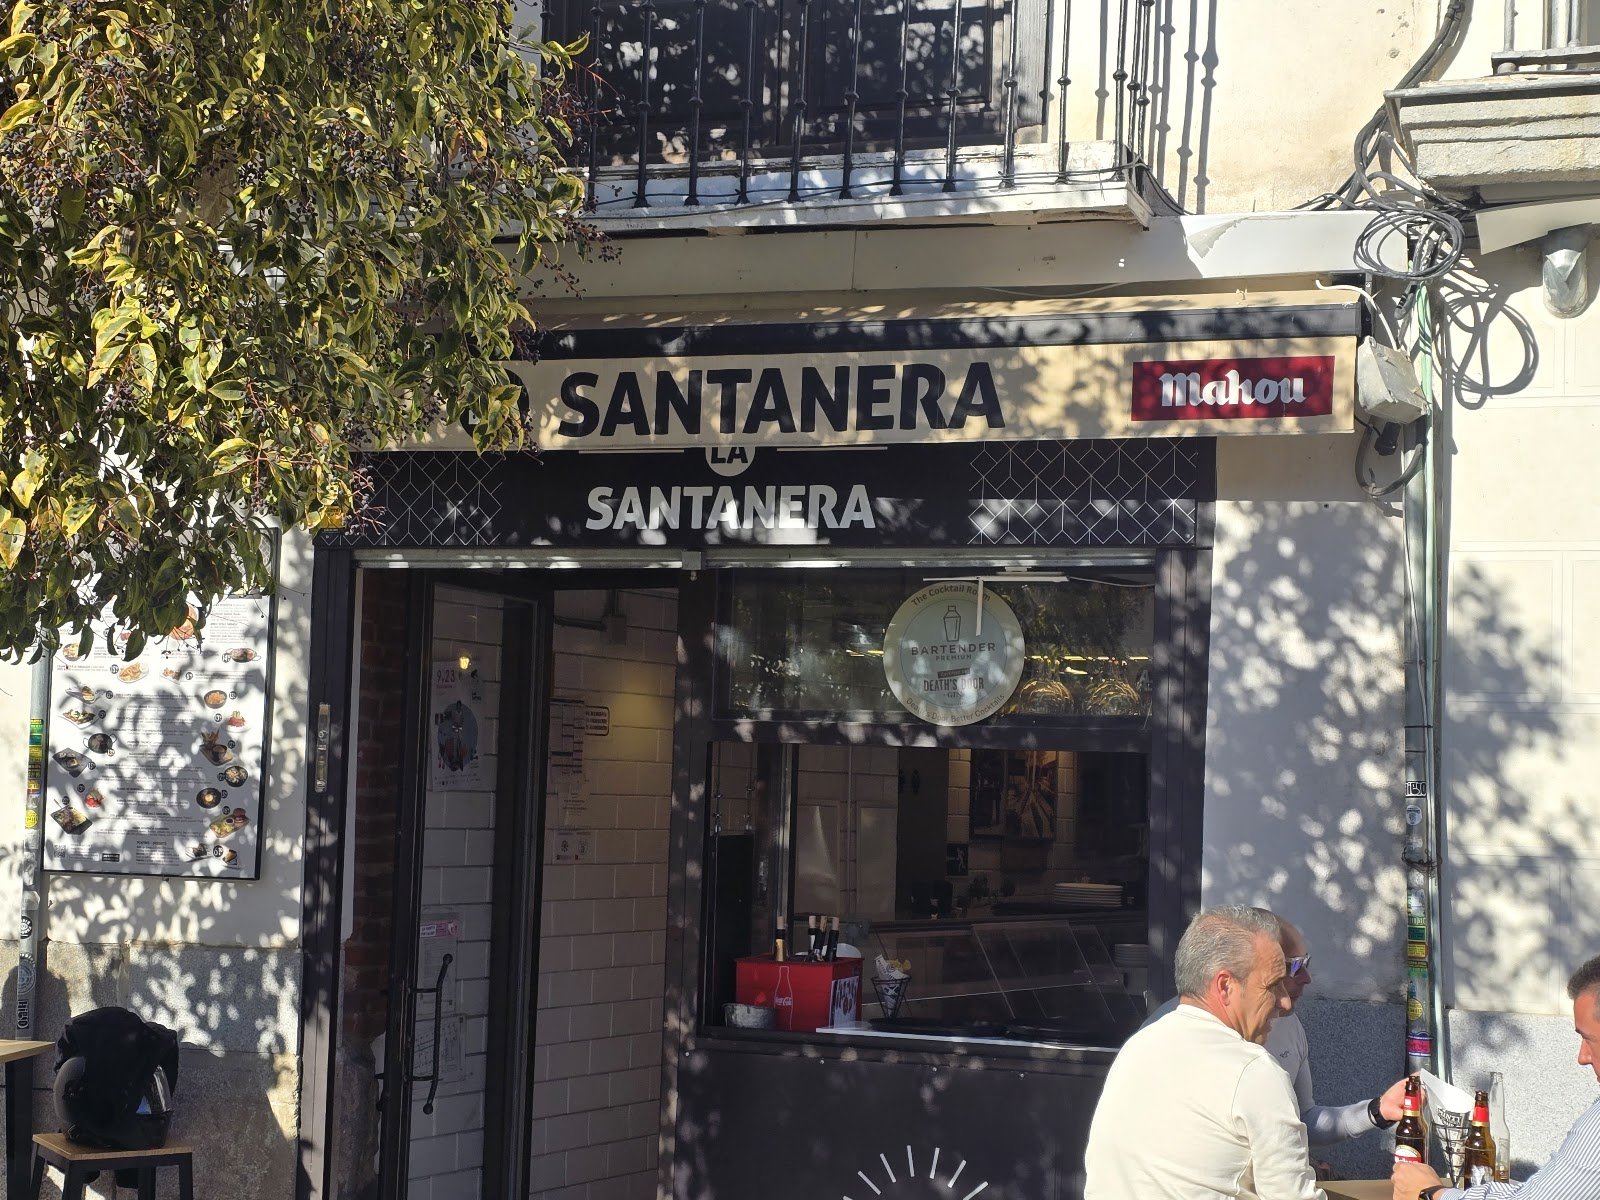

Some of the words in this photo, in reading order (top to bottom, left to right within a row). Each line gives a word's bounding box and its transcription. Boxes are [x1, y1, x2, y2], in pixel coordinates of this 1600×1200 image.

[558, 361, 1006, 438] SANTANERA
[1158, 369, 1306, 407] Mahou
[710, 446, 749, 464] LA
[586, 484, 876, 530] SANTANERA
[911, 594, 928, 606] The
[928, 584, 965, 597] Cocktail
[966, 585, 991, 602] Rom
[911, 642, 996, 656] BARTENDER
[923, 679, 958, 692] DEATH'S
[961, 677, 985, 690] DOOR
[950, 713, 975, 723] Better
[974, 694, 1005, 718] Cocktails
